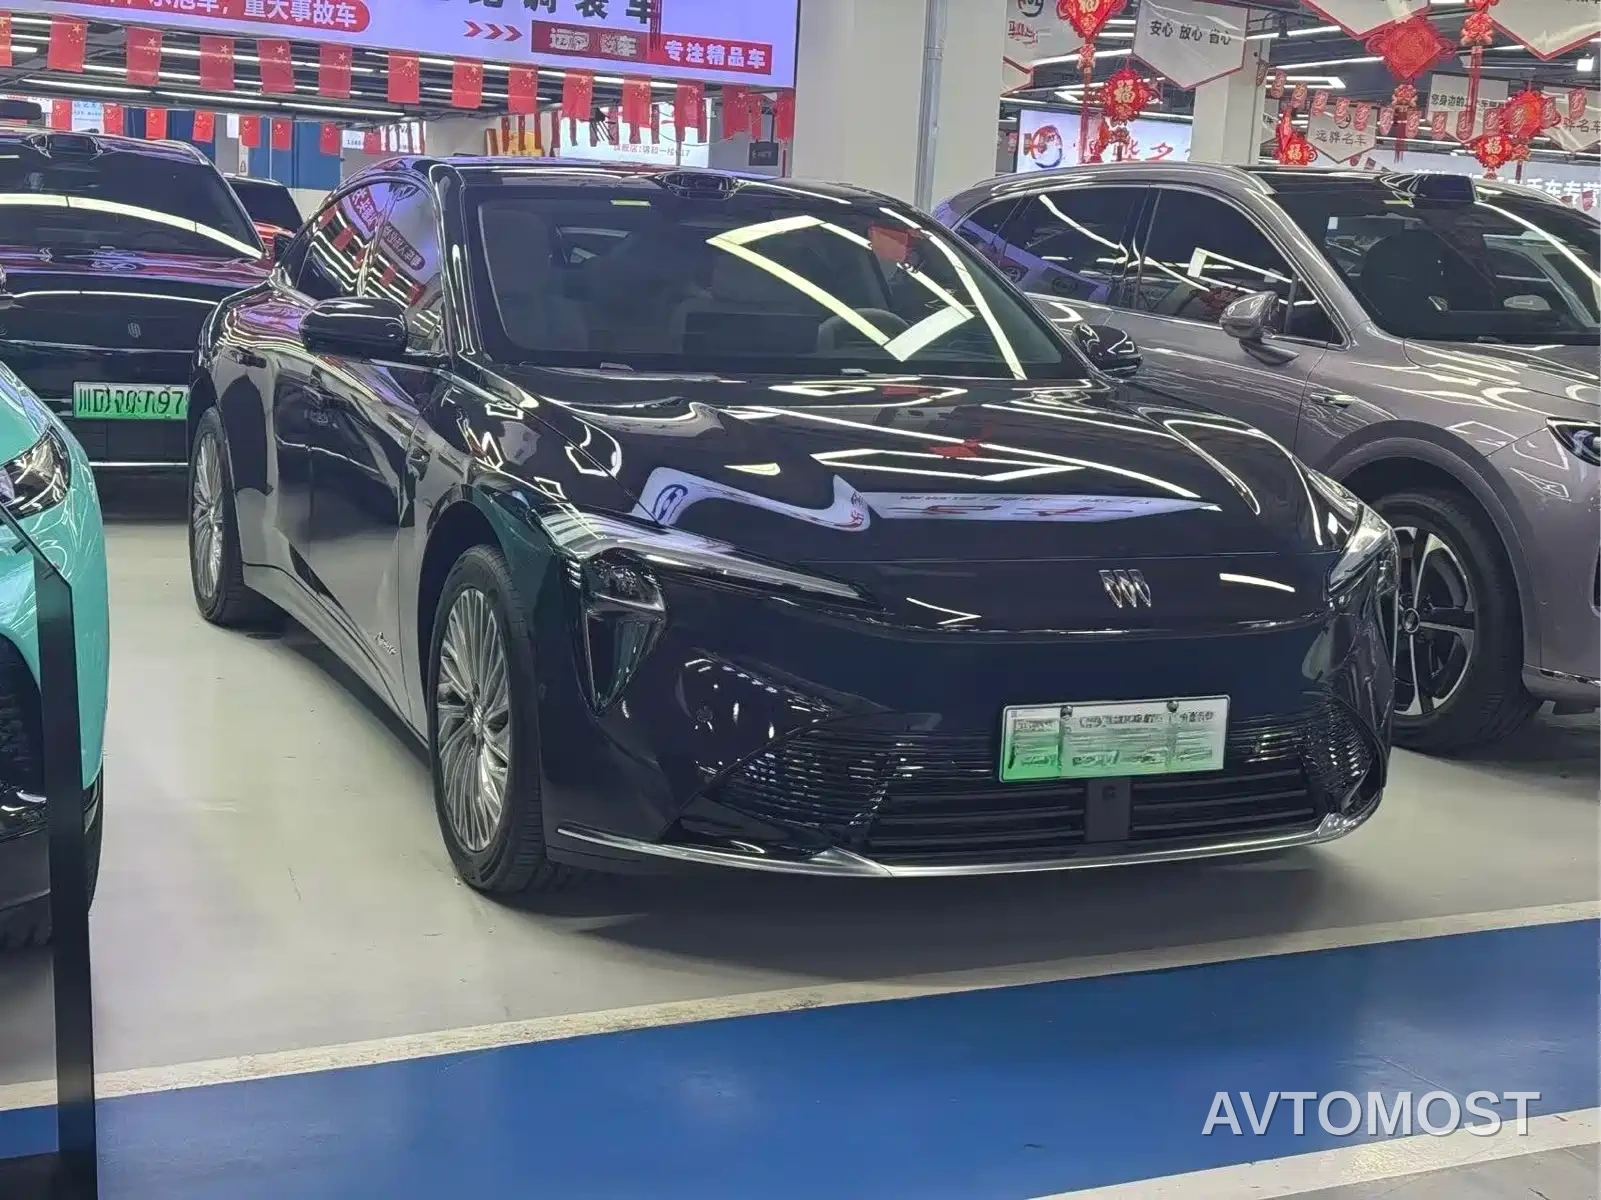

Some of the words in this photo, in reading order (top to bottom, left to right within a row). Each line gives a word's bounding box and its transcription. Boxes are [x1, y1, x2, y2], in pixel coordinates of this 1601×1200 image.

[1150, 20, 1173, 37] 安心
[1179, 24, 1202, 41] 放心
[665, 40, 766, 69] 专注精品车
